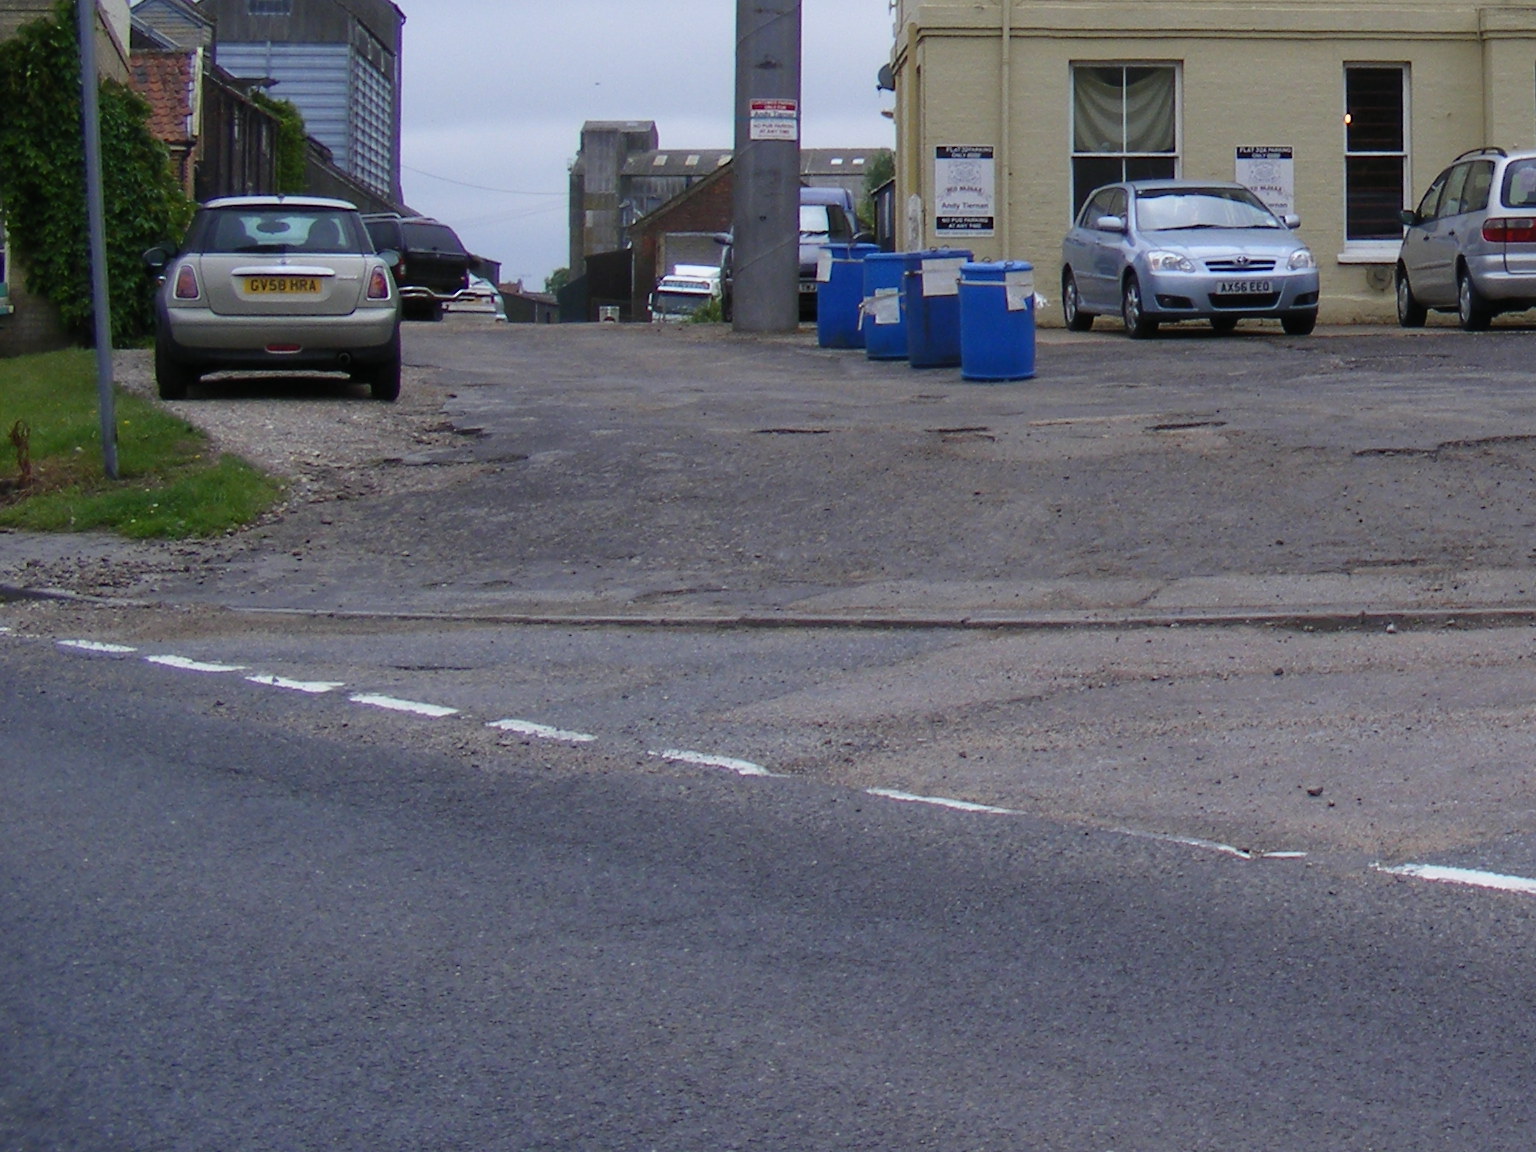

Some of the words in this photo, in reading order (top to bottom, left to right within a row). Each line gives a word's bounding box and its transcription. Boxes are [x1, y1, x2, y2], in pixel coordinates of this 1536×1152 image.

[251, 279, 286, 291] GV58
[290, 279, 316, 291] HRA
[1221, 282, 1248, 293] AX56
